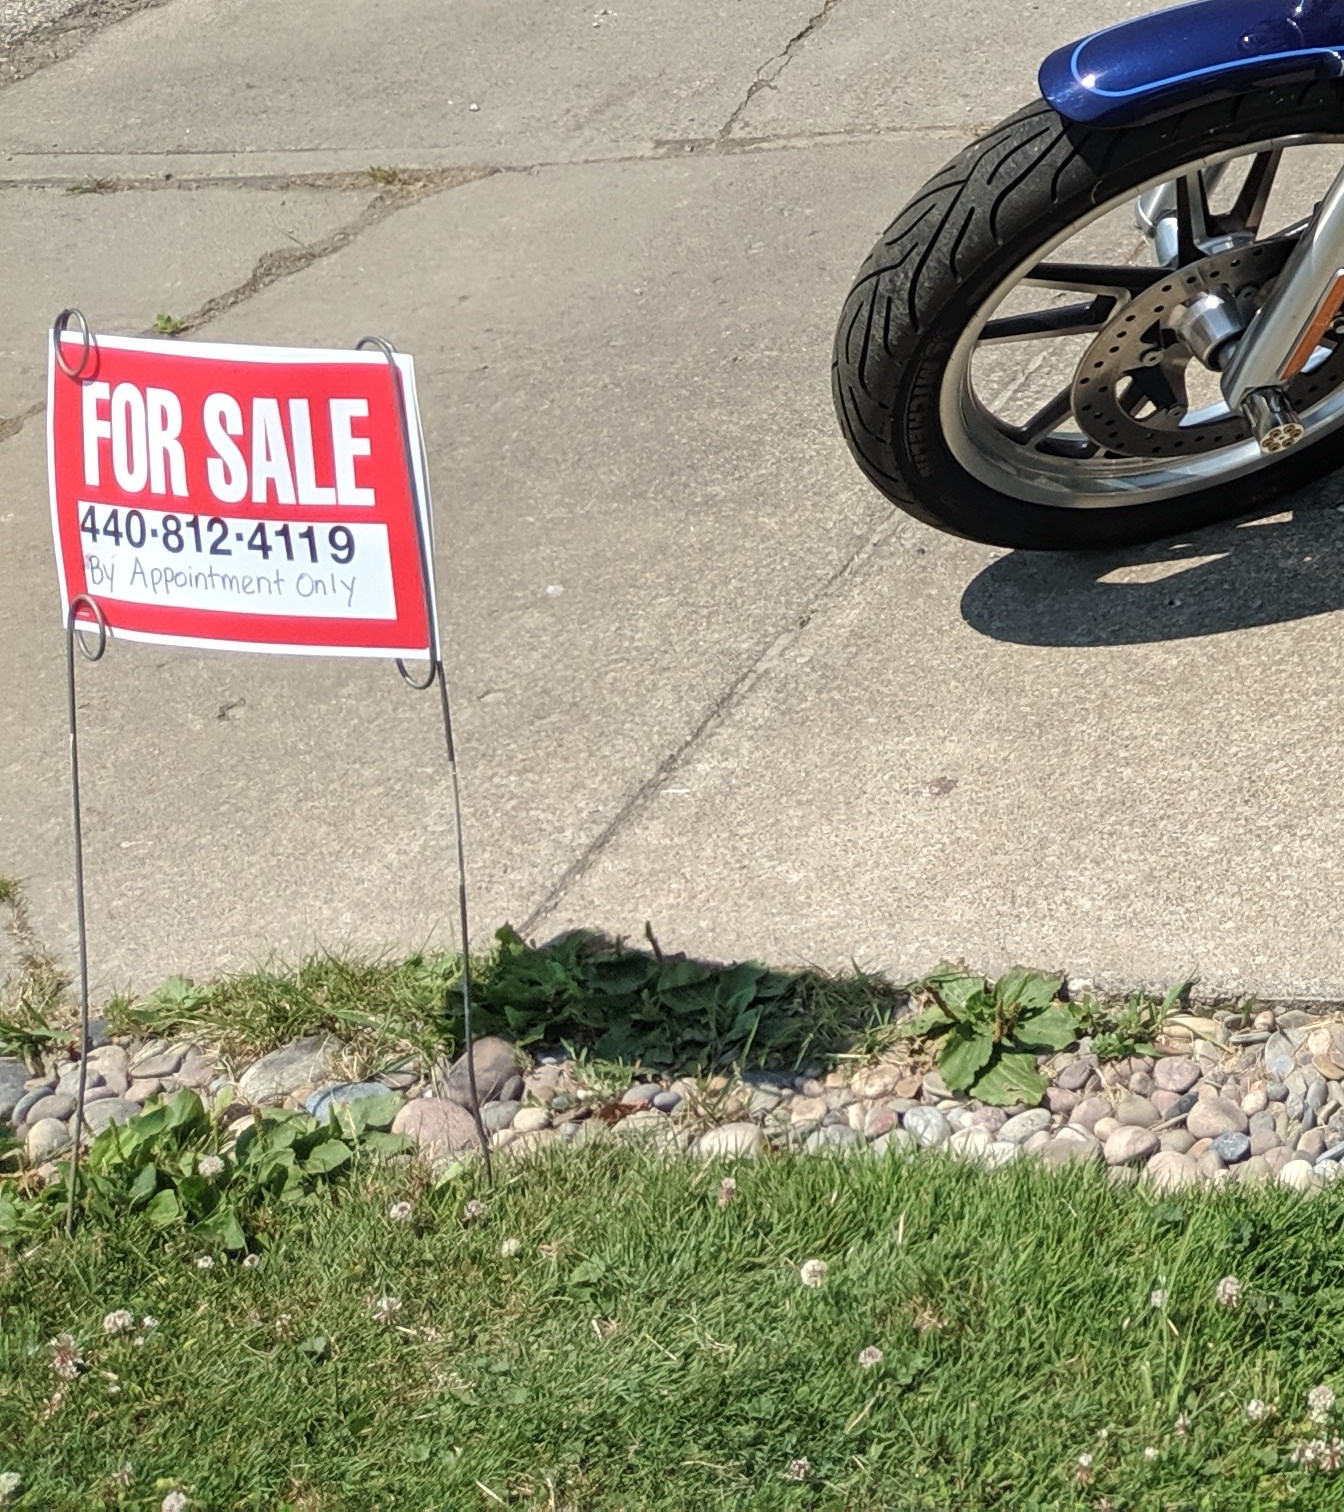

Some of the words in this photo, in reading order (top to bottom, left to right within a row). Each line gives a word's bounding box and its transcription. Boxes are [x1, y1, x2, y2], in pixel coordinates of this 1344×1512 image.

[82, 380, 190, 498] FOR
[203, 392, 376, 507] SALE
[88, 554, 115, 593] By
[129, 556, 286, 596] Appointment
[296, 573, 356, 608] Only
